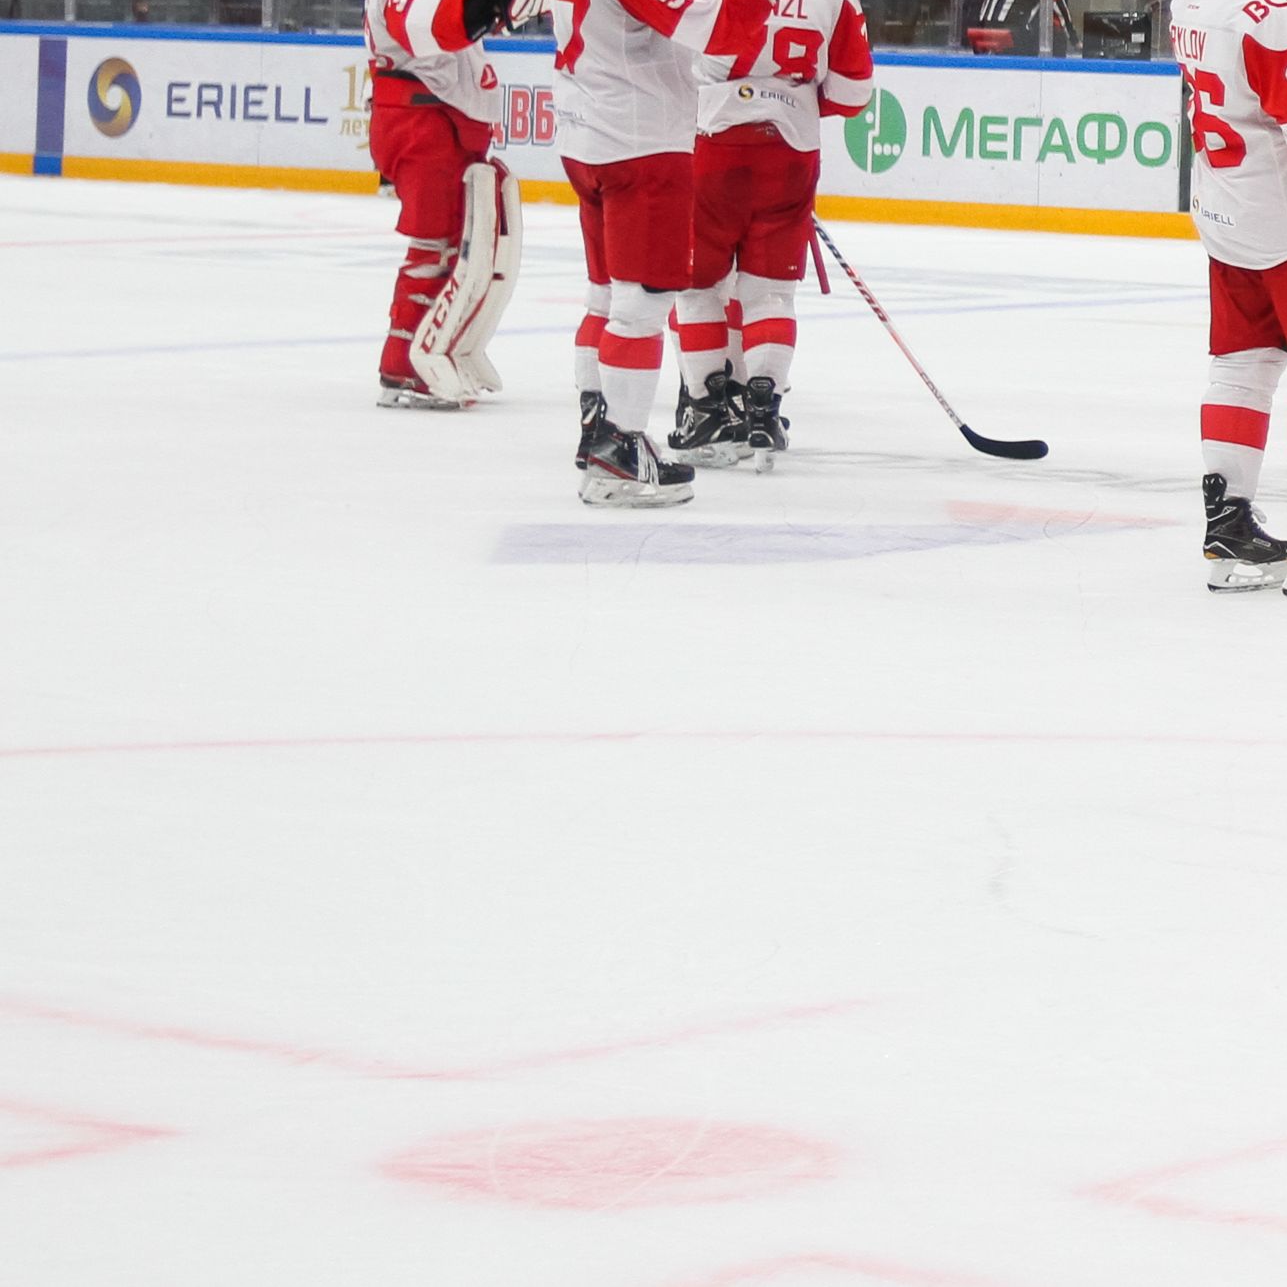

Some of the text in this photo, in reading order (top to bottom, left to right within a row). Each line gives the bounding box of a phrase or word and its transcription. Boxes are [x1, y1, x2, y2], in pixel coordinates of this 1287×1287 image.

[166, 81, 329, 125] ERIELL
[760, 89, 798, 109] ERIELL
[922, 105, 1180, 168] МЕГАФО
[421, 274, 460, 355] CCM
